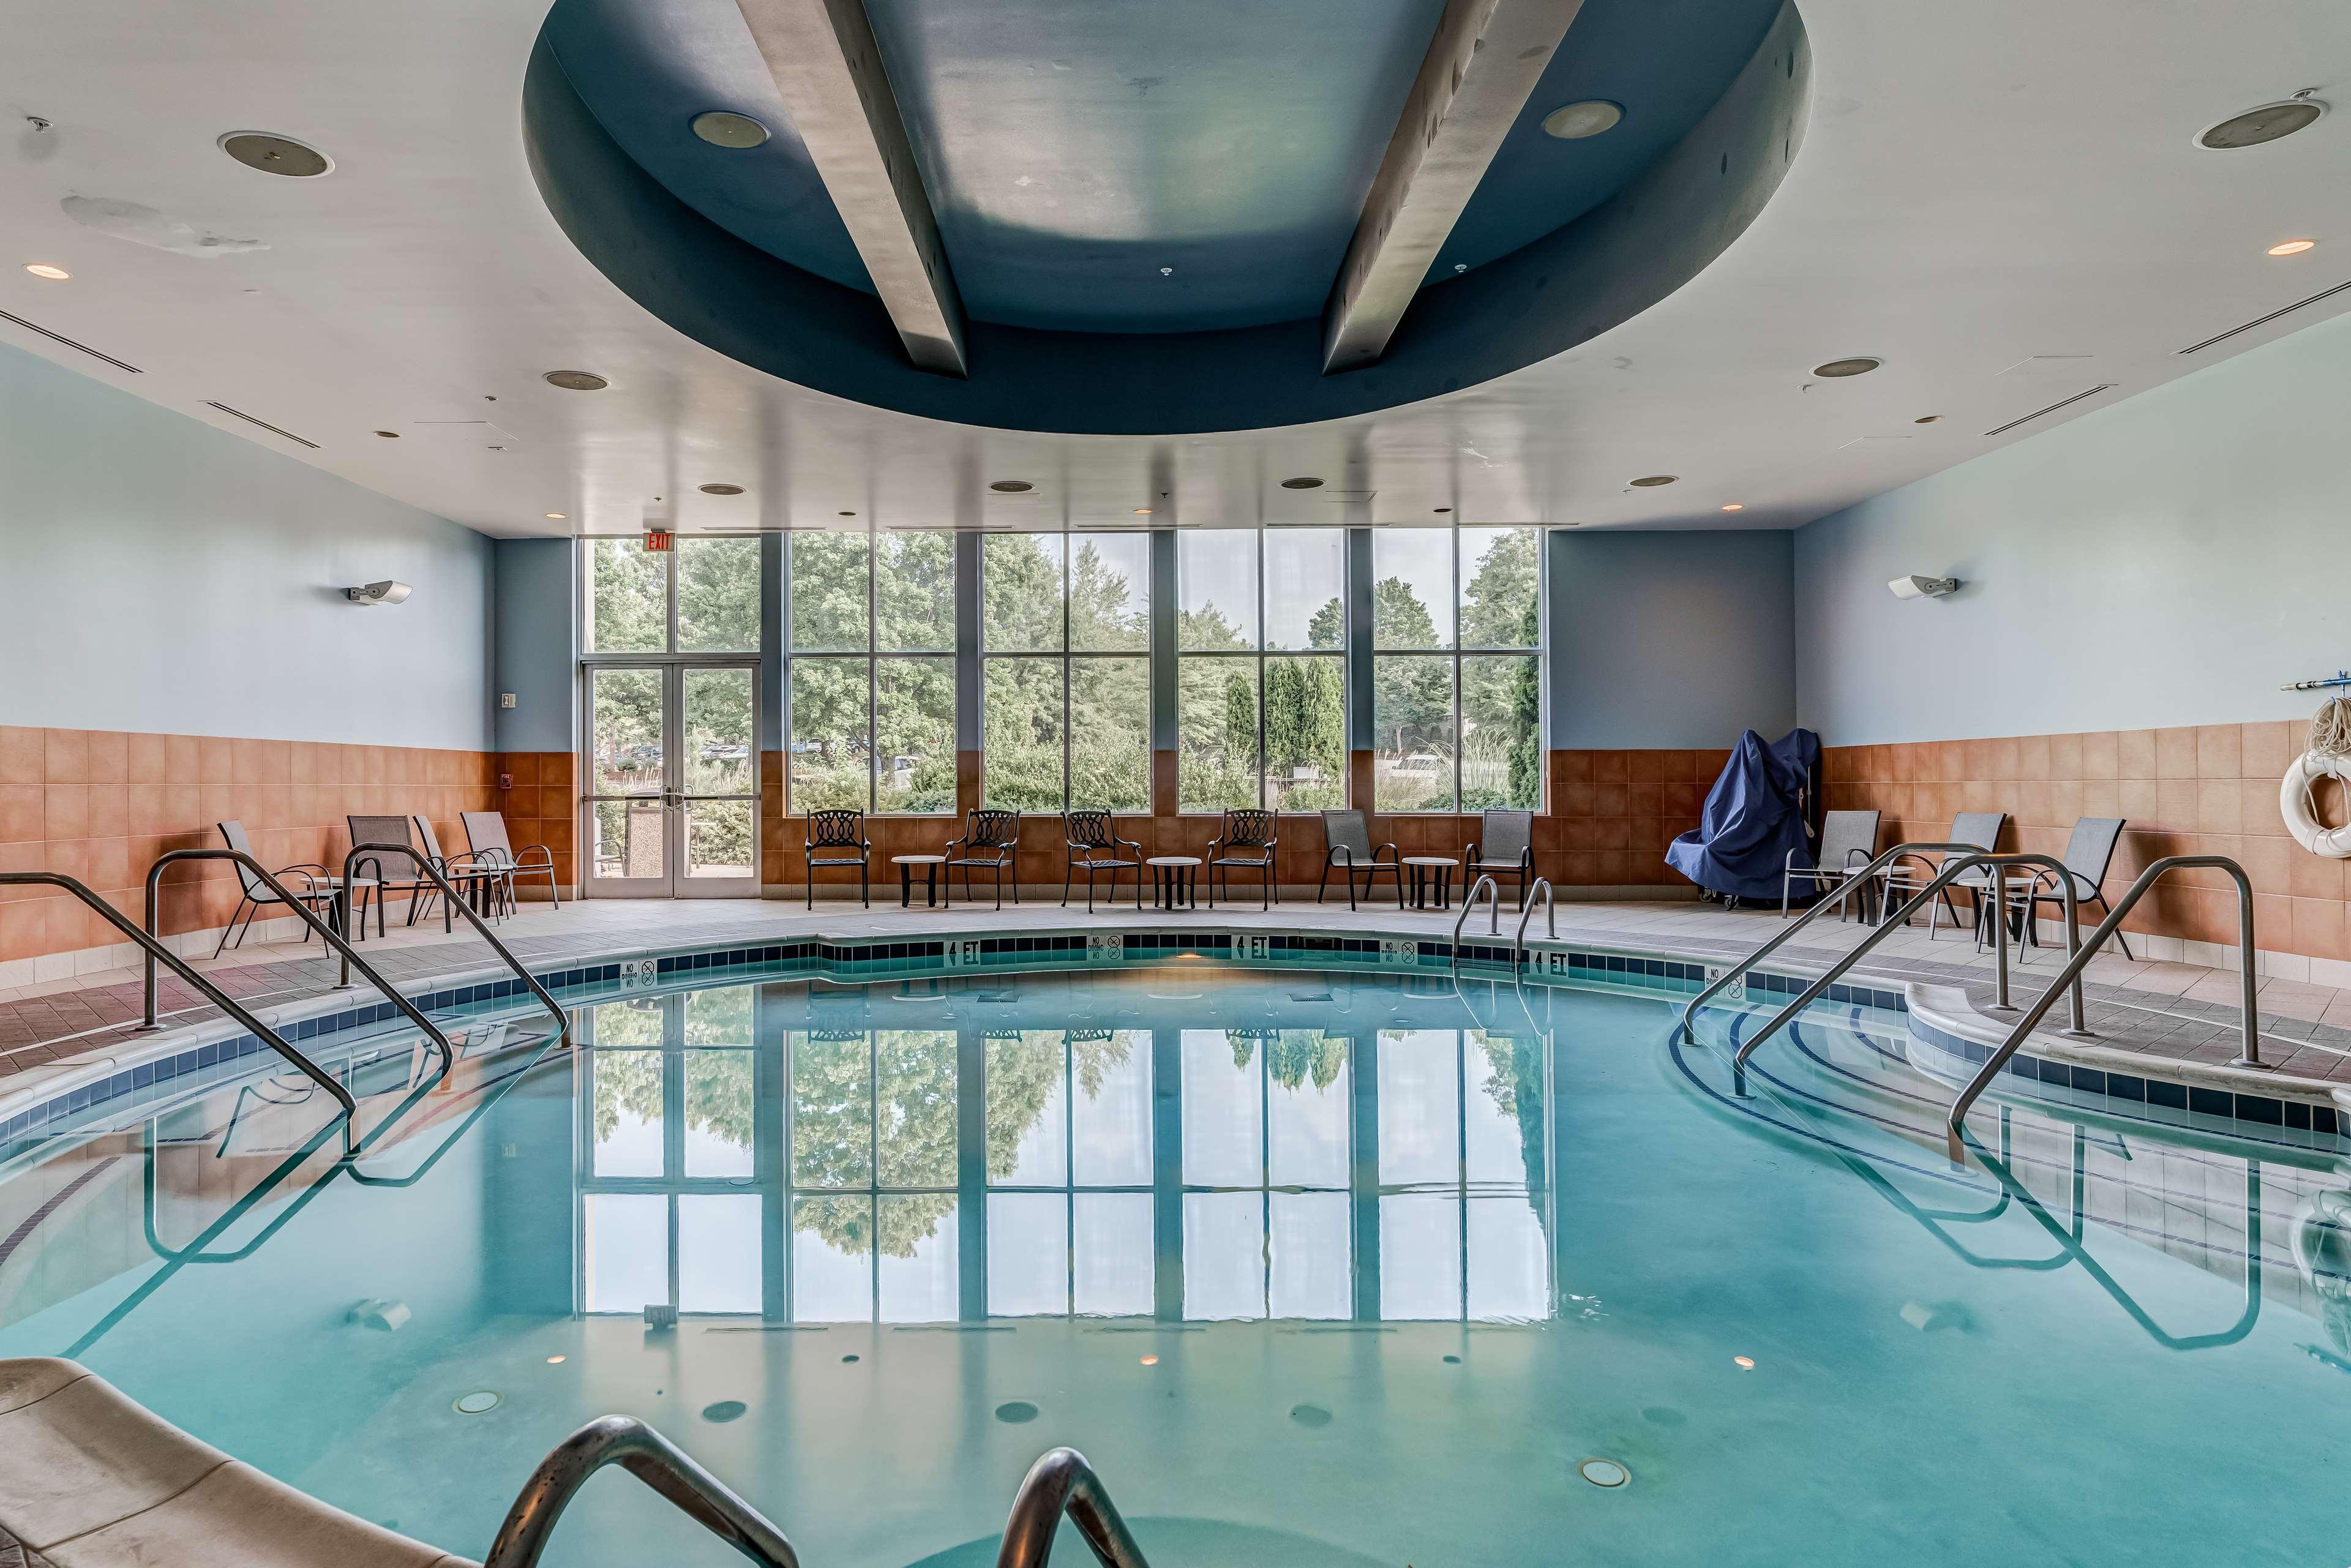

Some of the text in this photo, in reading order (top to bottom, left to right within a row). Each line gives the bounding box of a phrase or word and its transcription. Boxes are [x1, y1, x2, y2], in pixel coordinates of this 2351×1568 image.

[649, 533, 670, 549] EXIT
[626, 964, 633, 973] NO
[1711, 969, 1719, 978] NO
